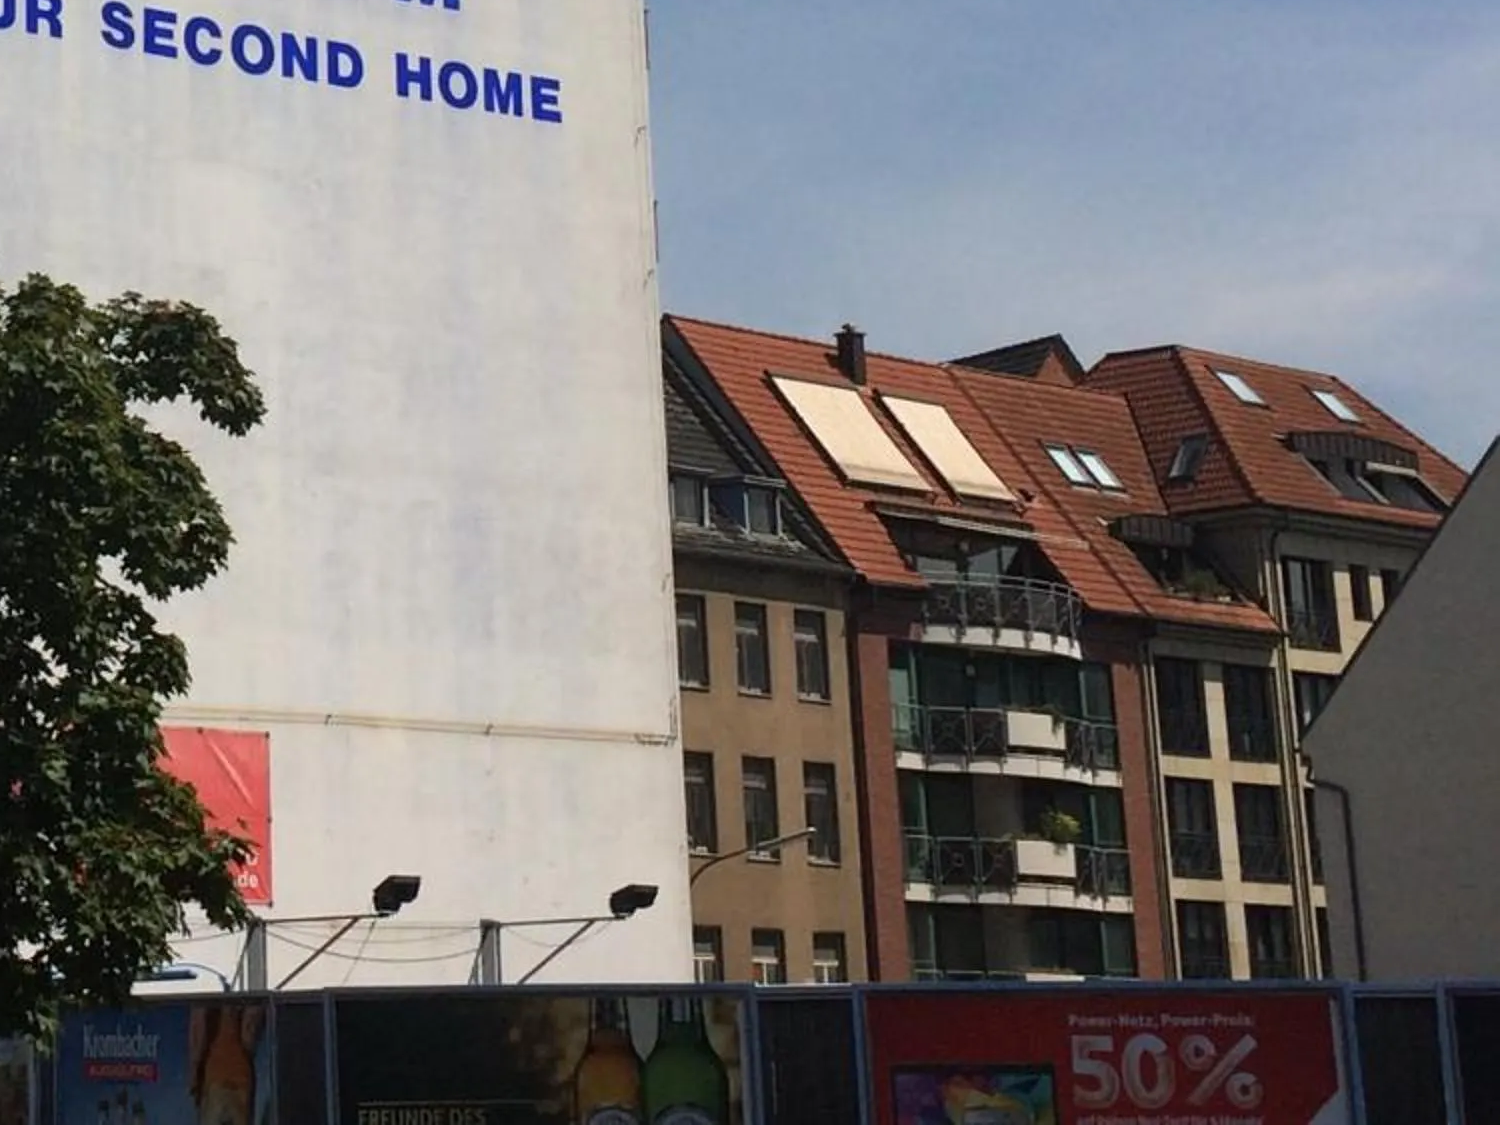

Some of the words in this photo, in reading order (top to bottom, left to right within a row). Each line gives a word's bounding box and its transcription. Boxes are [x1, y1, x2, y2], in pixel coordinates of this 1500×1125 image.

[102, 1, 364, 88] SECOND
[395, 53, 563, 123] HOME
[83, 1023, 161, 1059] Krombacher
[1071, 1033, 1265, 1110] 50%
